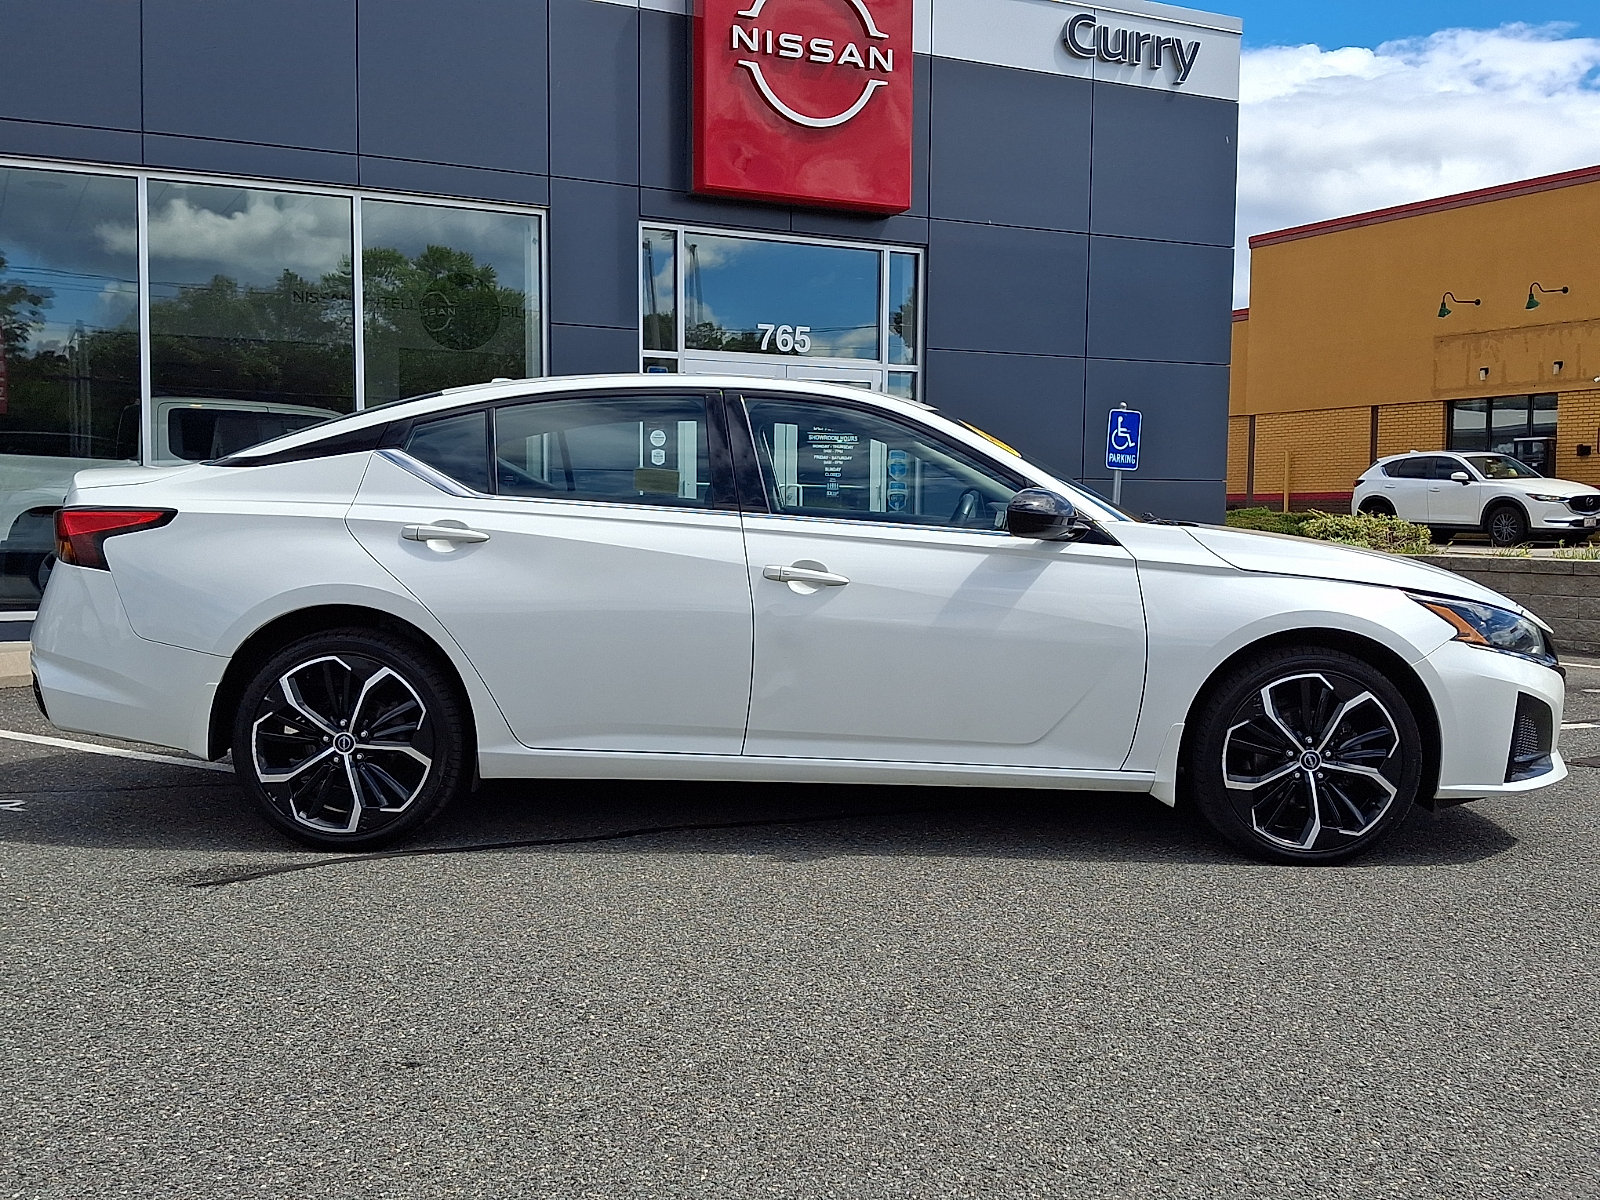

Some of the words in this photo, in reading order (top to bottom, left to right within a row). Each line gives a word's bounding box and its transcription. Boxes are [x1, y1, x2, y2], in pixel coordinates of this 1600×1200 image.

[732, 24, 894, 72] NISSAN
[1064, 13, 1201, 84] Curry
[757, 323, 812, 353] 765
[1109, 452, 1136, 464] PARKING
